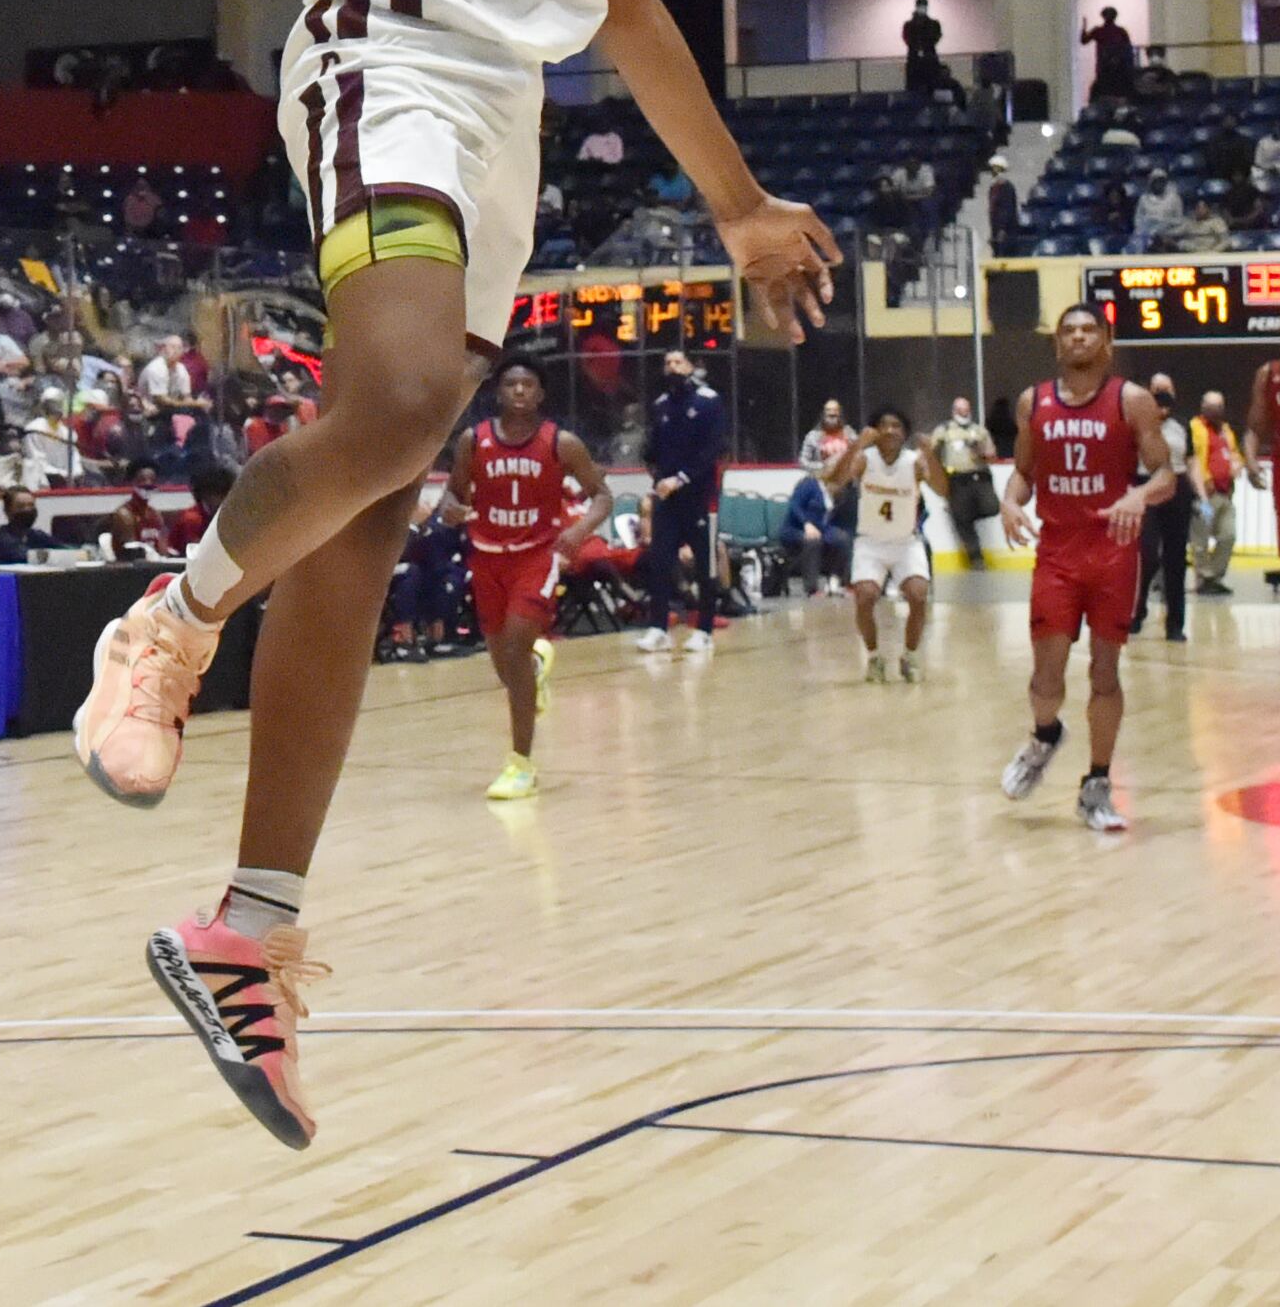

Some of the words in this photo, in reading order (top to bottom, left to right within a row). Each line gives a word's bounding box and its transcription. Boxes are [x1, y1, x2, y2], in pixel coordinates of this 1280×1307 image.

[1140, 299, 1162, 330] 5
[1183, 286, 1228, 324] 47
[1042, 418, 1108, 441] SANDY
[485, 457, 543, 479] SANDY
[1063, 442, 1087, 472] 12
[510, 479, 520, 506] 1
[1048, 473, 1106, 496] CREEK
[488, 506, 540, 528] CREEK
[878, 500, 894, 522] 4
